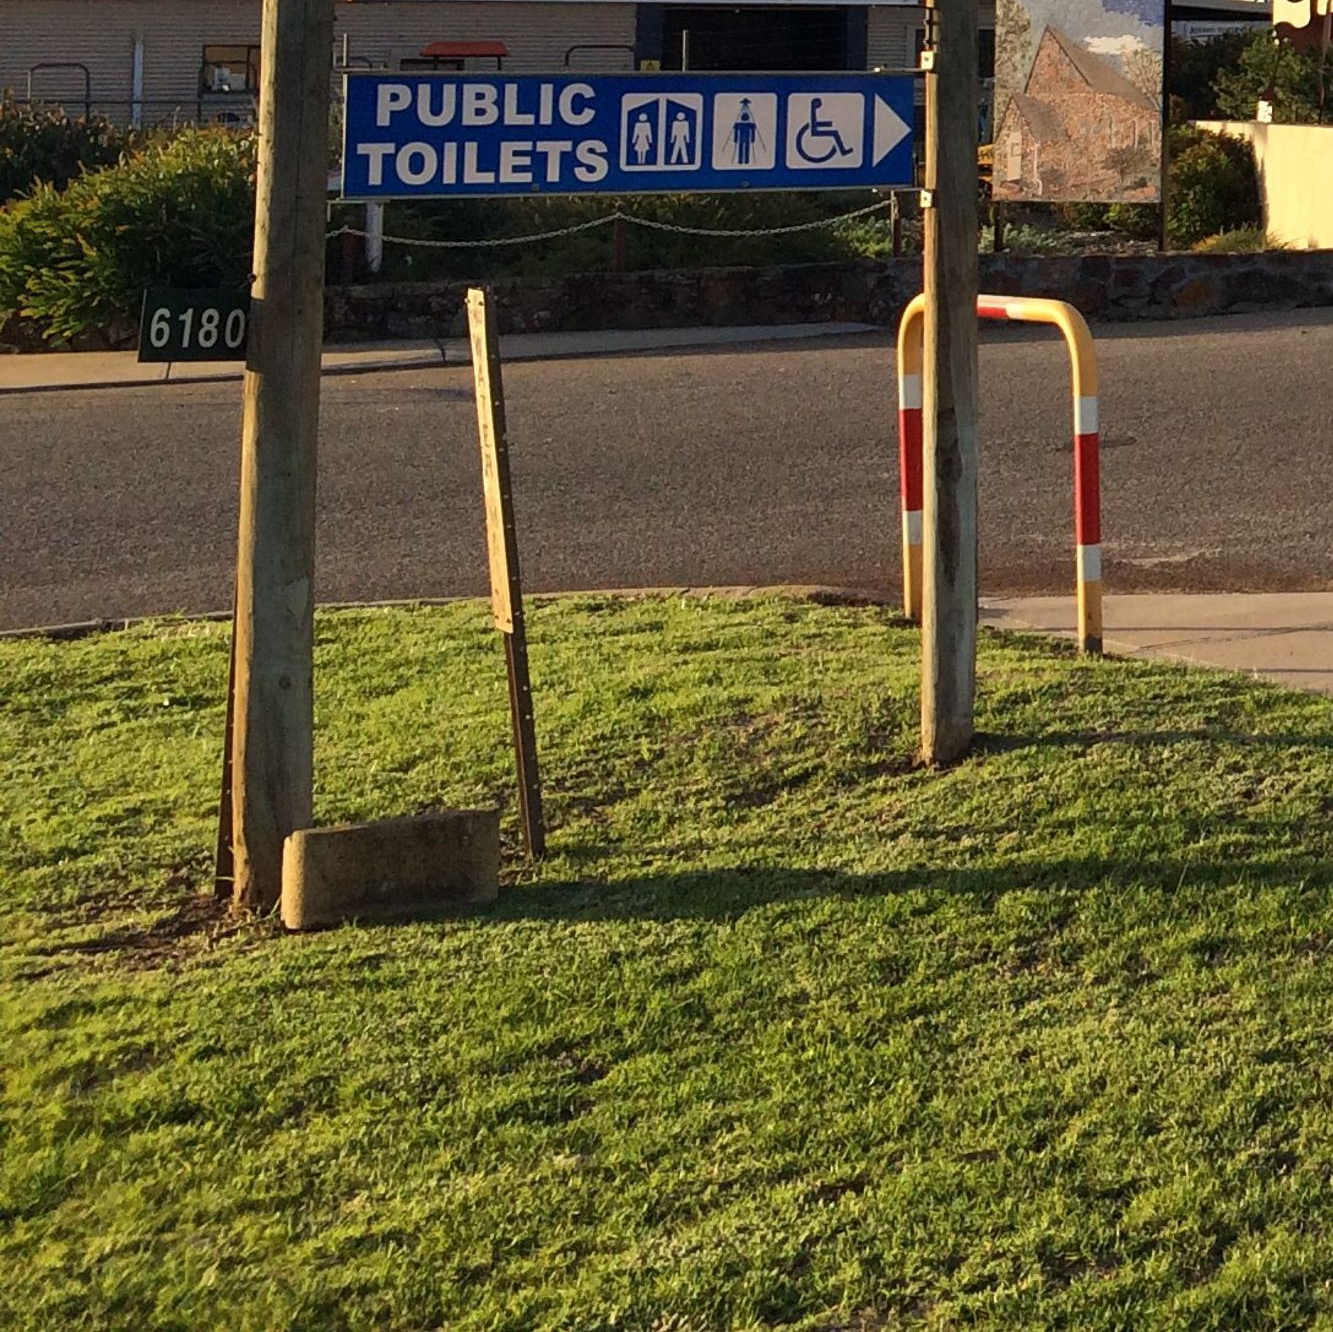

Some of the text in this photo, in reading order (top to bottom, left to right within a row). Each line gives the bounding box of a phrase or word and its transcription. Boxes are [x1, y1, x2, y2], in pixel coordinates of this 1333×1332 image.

[375, 83, 596, 127] PUBLIC
[357, 140, 609, 186] TOILETS
[150, 308, 246, 348] 6180
